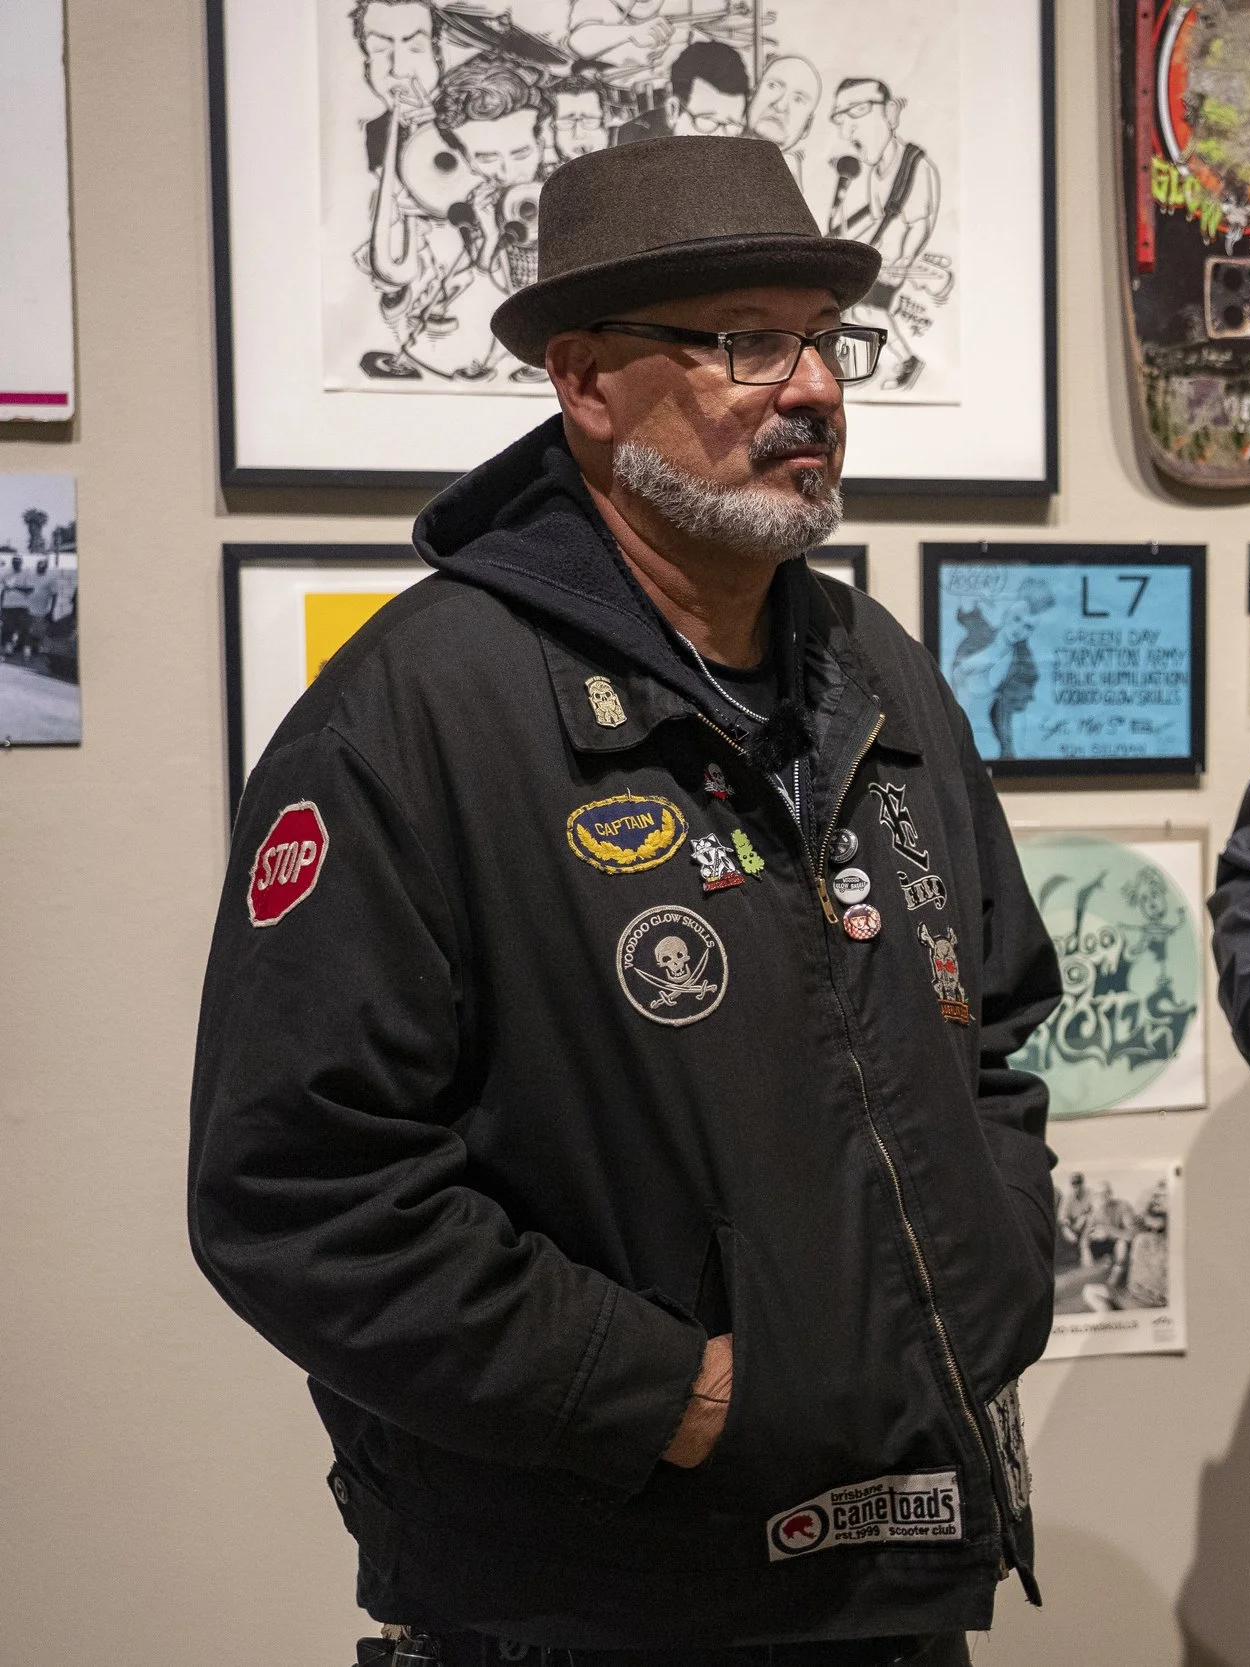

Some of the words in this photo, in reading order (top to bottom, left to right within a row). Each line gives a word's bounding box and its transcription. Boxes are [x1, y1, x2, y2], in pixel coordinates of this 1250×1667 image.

[1082, 574, 1151, 618] L7
[1064, 628, 1122, 646] GREEN
[1127, 628, 1161, 646] DAY
[1053, 647, 1140, 668] STARVATION
[1053, 671, 1096, 686] PUBLIC
[594, 812, 655, 836] CAPTAIN
[258, 841, 317, 890] STOP
[624, 922, 650, 969] VOODOO
[650, 913, 682, 926] GLOW
[682, 916, 715, 948] SKULLS
[831, 1483, 884, 1501] brisbane
[889, 1525, 929, 1537] scooter
[931, 1523, 957, 1536] club
